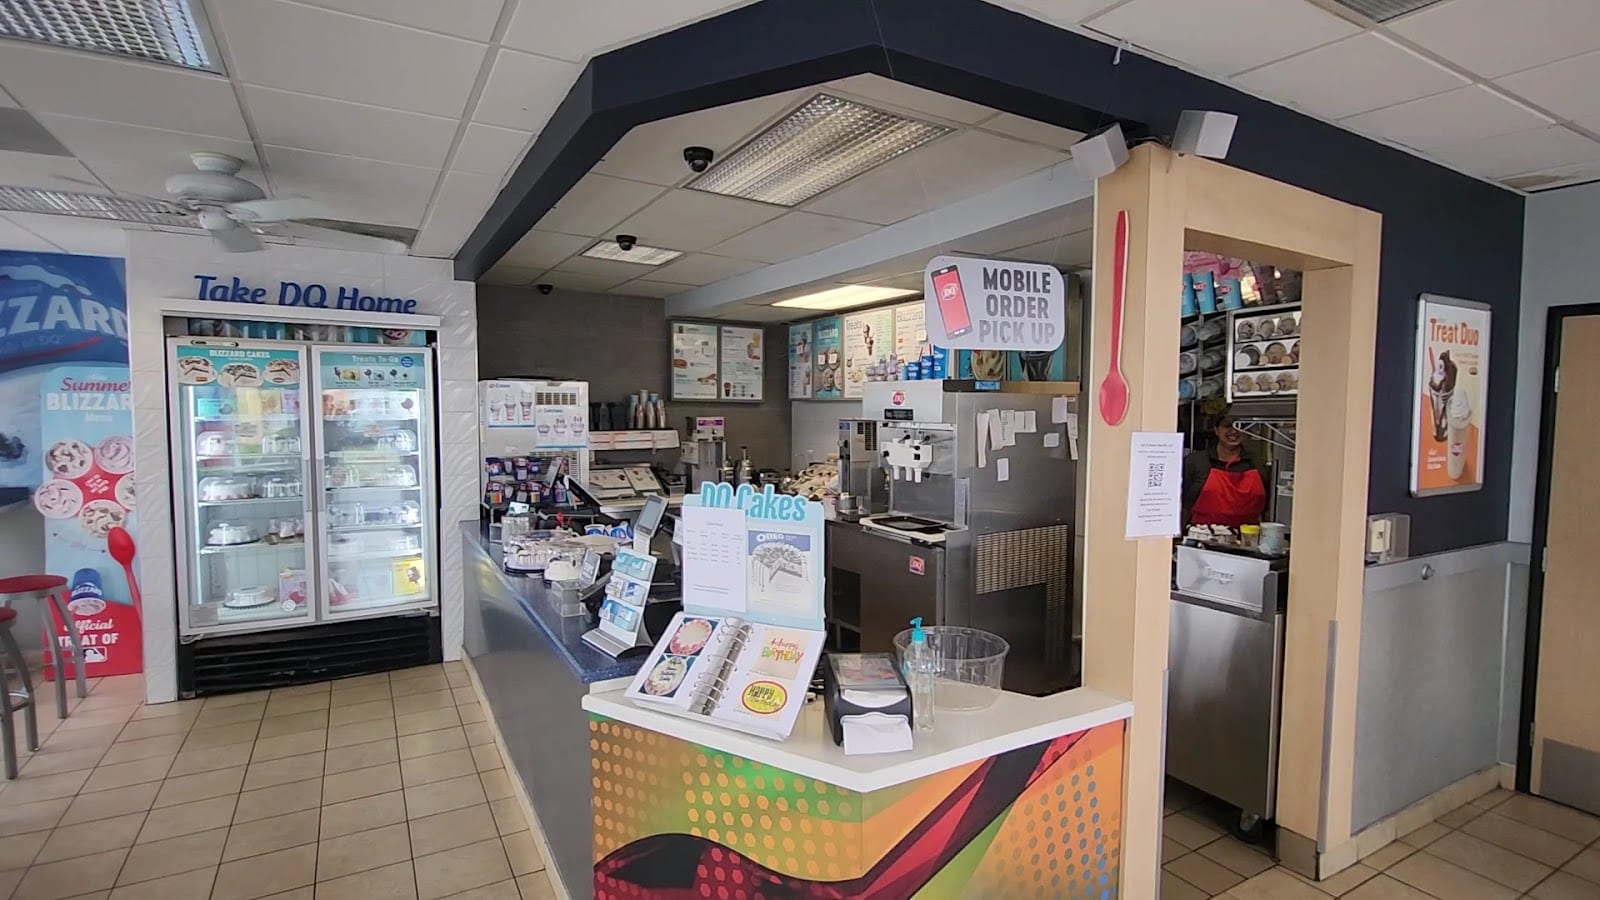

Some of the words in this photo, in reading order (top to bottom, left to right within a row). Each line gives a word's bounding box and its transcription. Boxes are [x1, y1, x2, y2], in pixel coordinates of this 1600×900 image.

[982, 266, 1051, 294] MOBILE
[194, 274, 267, 304] Take
[278, 281, 329, 308] DQ
[336, 286, 417, 314] Home
[985, 294, 1049, 319] ORDER
[979, 319, 1025, 344] PICK
[1031, 321, 1056, 345] UP
[1429, 318, 1458, 344] Treat
[1460, 322, 1479, 346] Duo
[209, 349, 246, 358] BLIZZARD
[61, 377, 131, 391] Summe
[737, 484, 807, 521] Cakes
[58, 634, 98, 647] TRAT
[101, 633, 119, 645] OF
